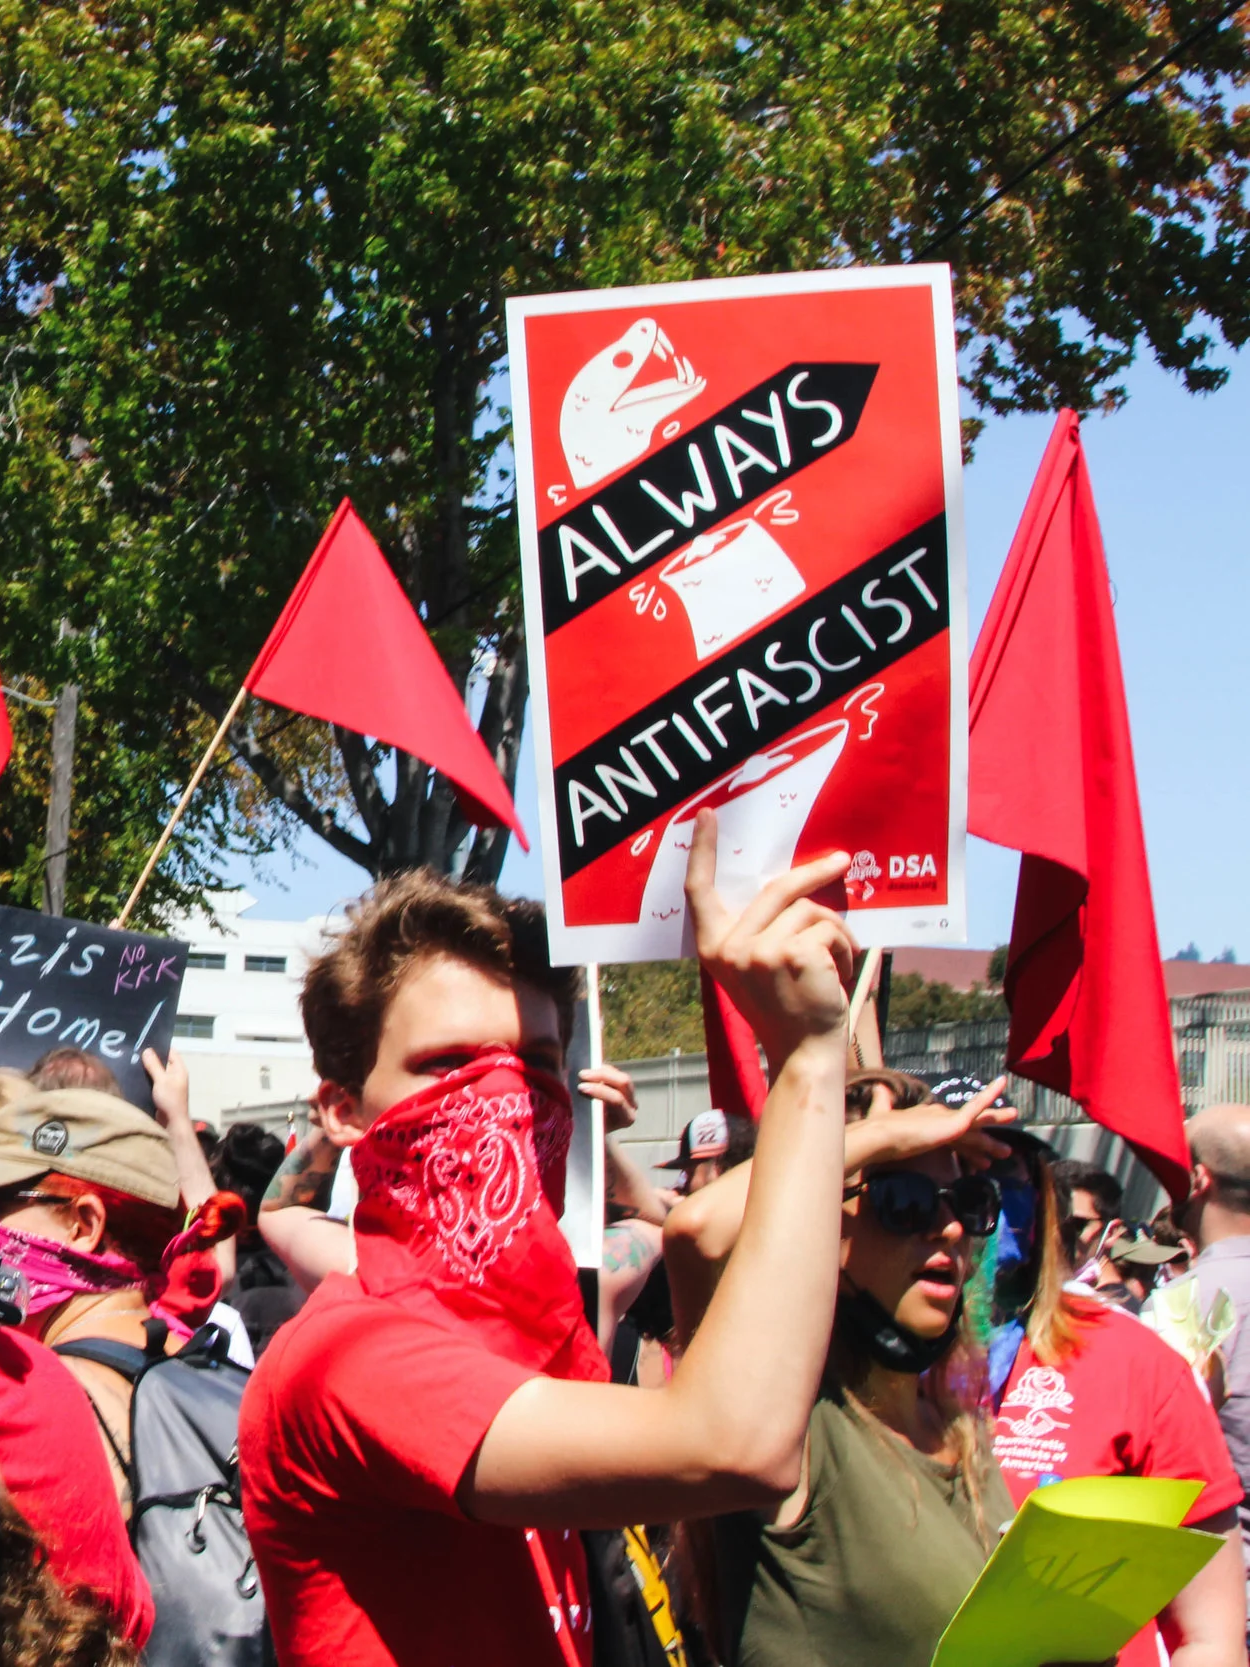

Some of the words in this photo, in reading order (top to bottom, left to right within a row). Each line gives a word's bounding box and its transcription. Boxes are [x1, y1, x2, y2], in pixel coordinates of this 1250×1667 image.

[558, 371, 844, 602] ALWAYS
[568, 547, 941, 848] ANTIFASCIST
[889, 853, 937, 879] DSA
[119, 944, 146, 968] NO
[994, 1435, 1066, 1452] Democratic
[999, 1457, 1054, 1472] America
[1051, 1451, 1068, 1463] of
